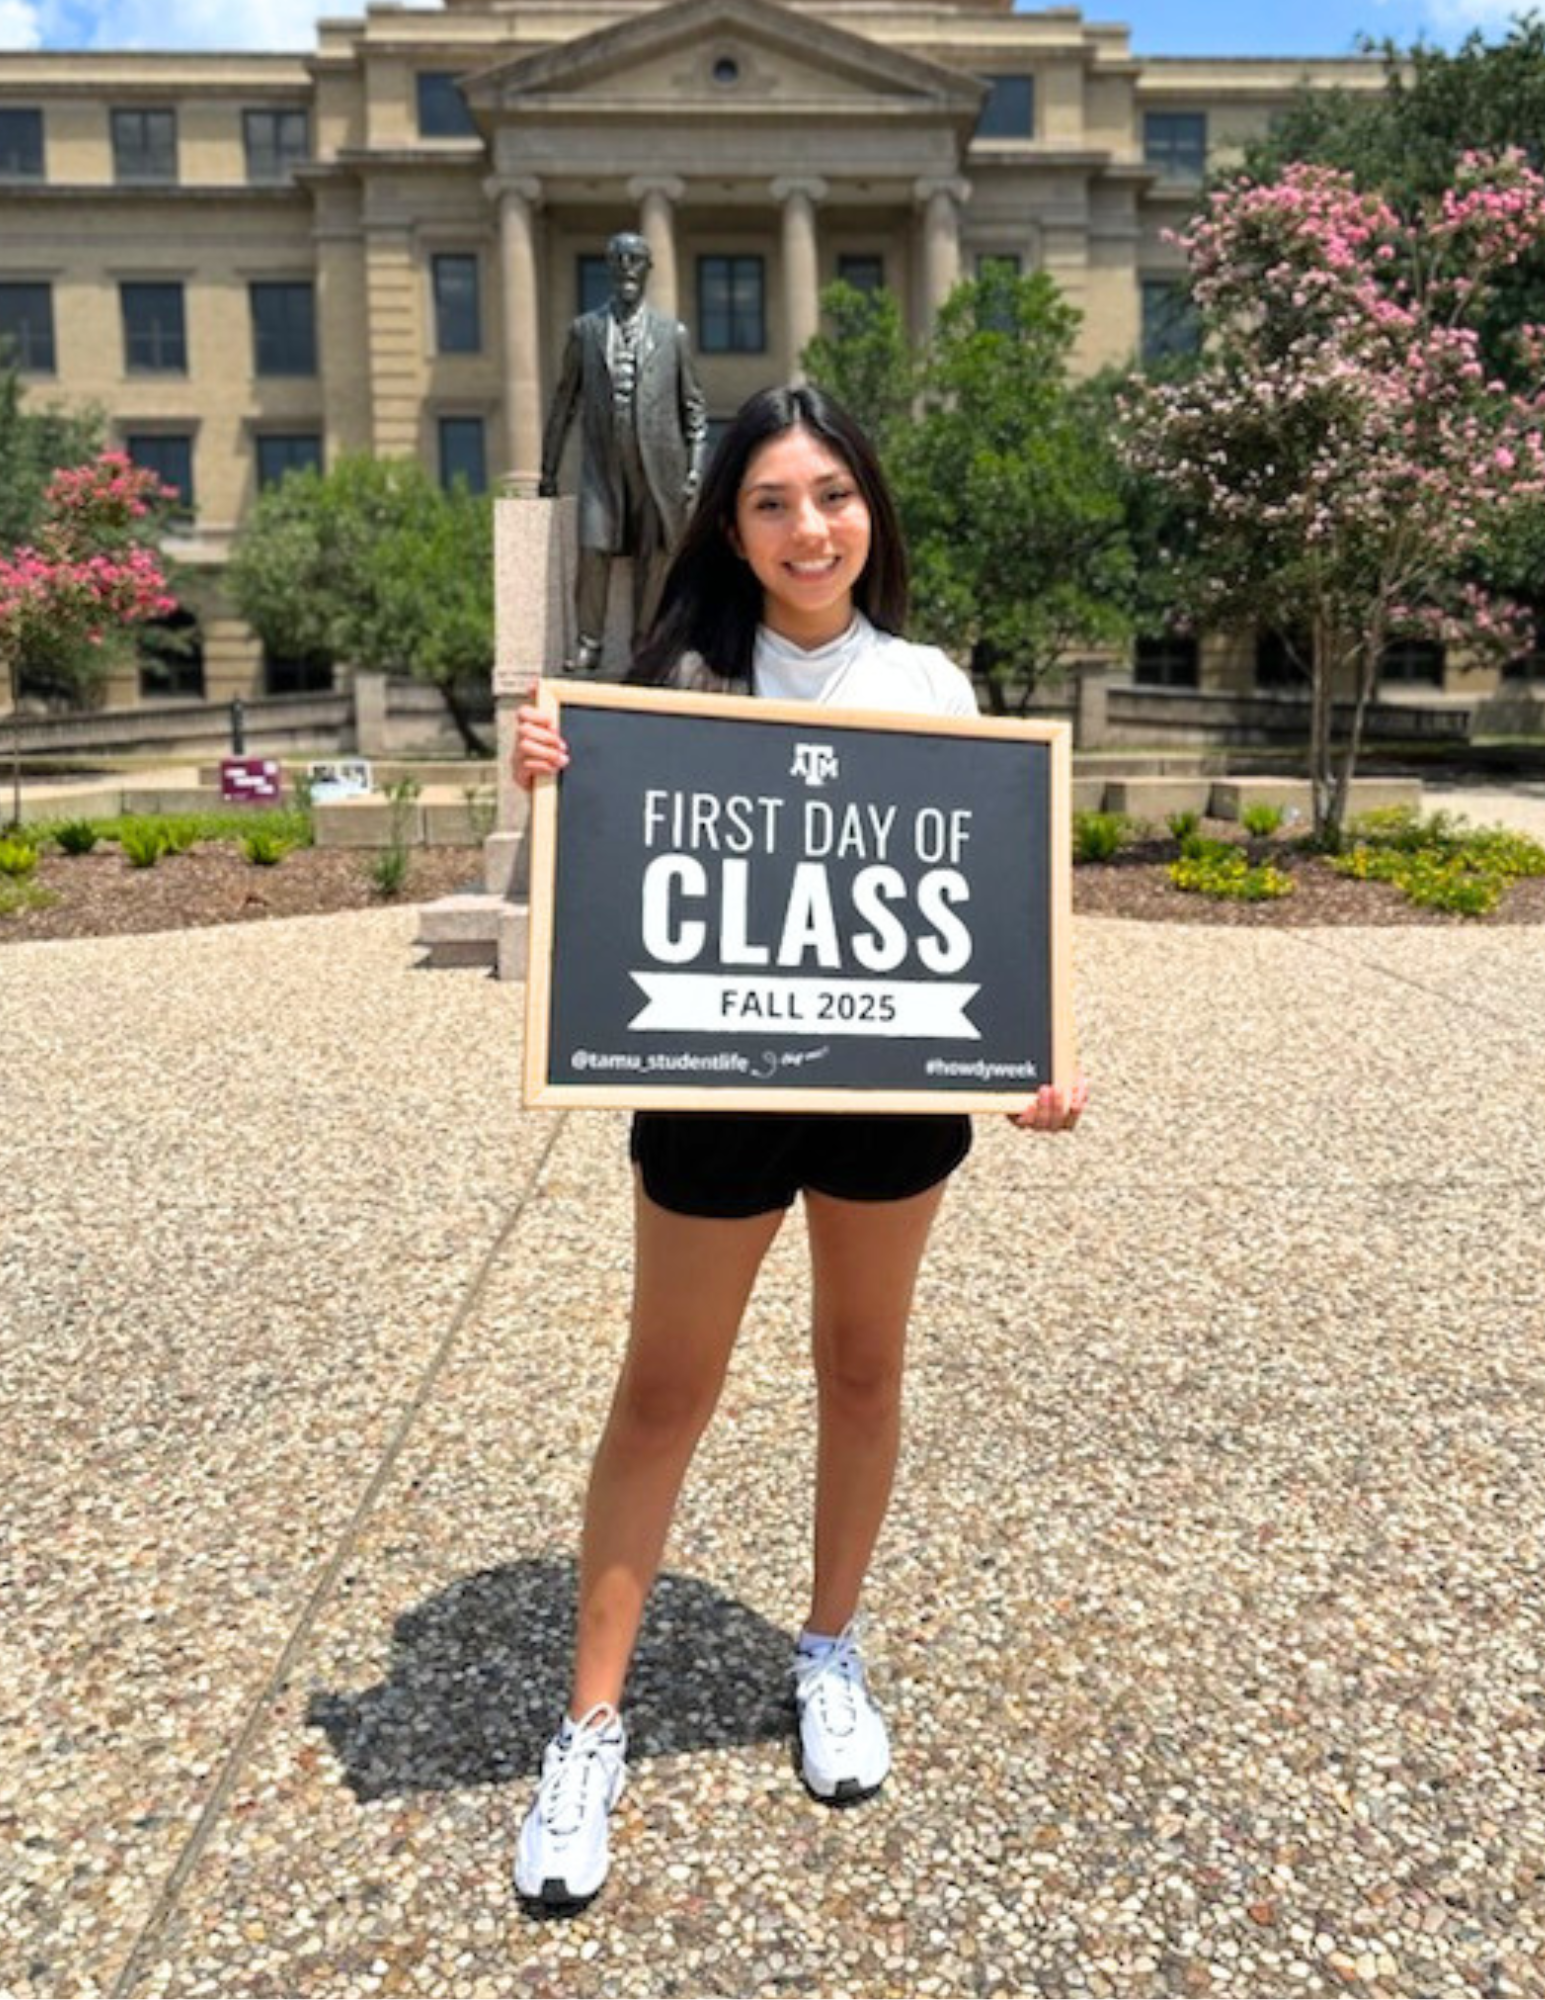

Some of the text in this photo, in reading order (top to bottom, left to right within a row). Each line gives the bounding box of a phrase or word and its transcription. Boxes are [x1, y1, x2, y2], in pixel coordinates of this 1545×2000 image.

[642, 788, 974, 865] FIRST DAY OF
[640, 852, 974, 974] CLASS
[720, 990, 897, 1022] FALL 2025
[570, 1049, 750, 1073] @tamu_studentlife
[925, 1058, 1037, 1081] #howdyweek
